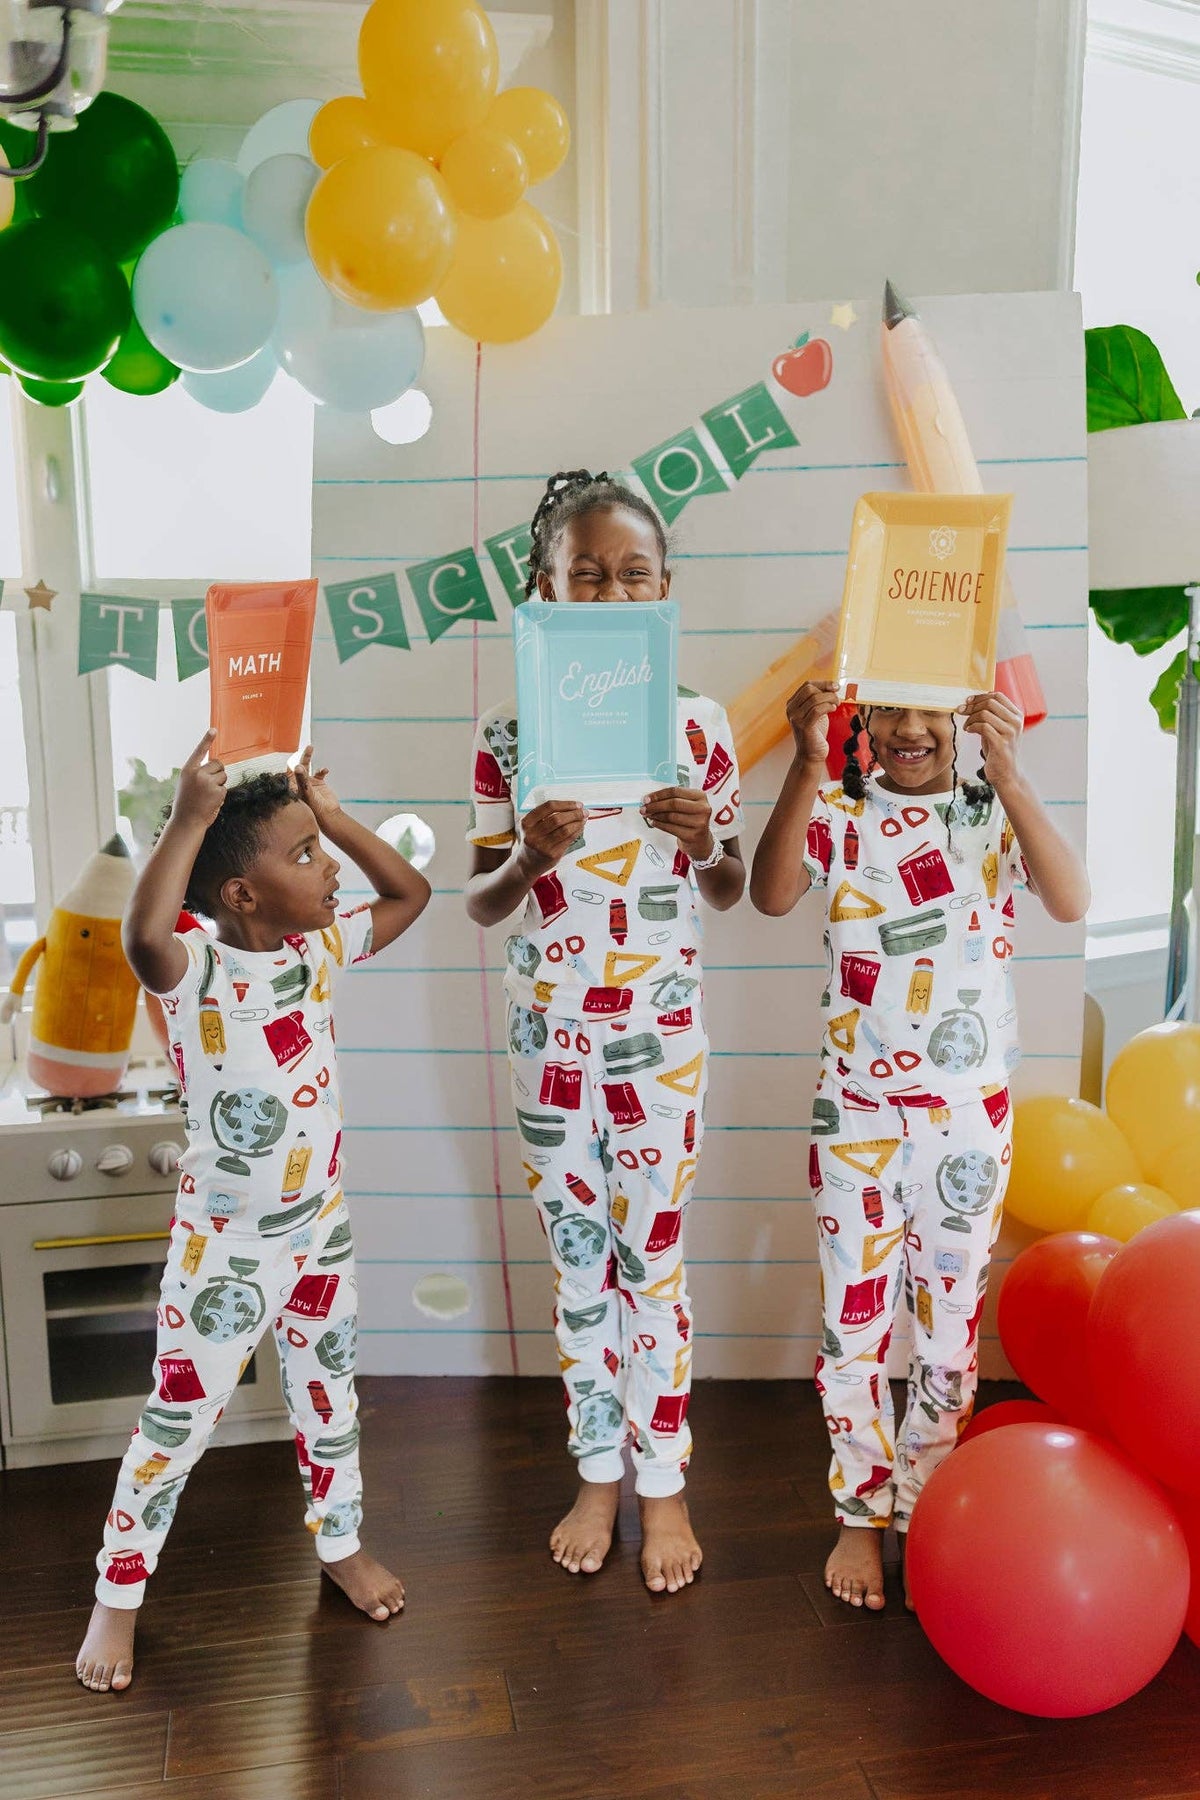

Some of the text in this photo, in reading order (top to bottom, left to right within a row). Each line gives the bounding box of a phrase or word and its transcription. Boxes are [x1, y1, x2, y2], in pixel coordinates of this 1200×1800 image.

[348, 404, 776, 640] SCHOL
[888, 568, 985, 604] SCIENCE
[229, 652, 281, 678] MATH
[559, 654, 653, 708] English
[704, 768, 725, 786] MAT
[916, 853, 943, 871] MATH
[853, 962, 879, 977] MATH
[277, 1045, 297, 1061] MATH
[559, 1072, 581, 1084] MATH
[990, 1105, 1007, 1121] MATH
[289, 1300, 312, 1311] MAT
[843, 1309, 871, 1321] MATH
[169, 1365, 193, 1375] MATH
[117, 1558, 144, 1571] MATH
